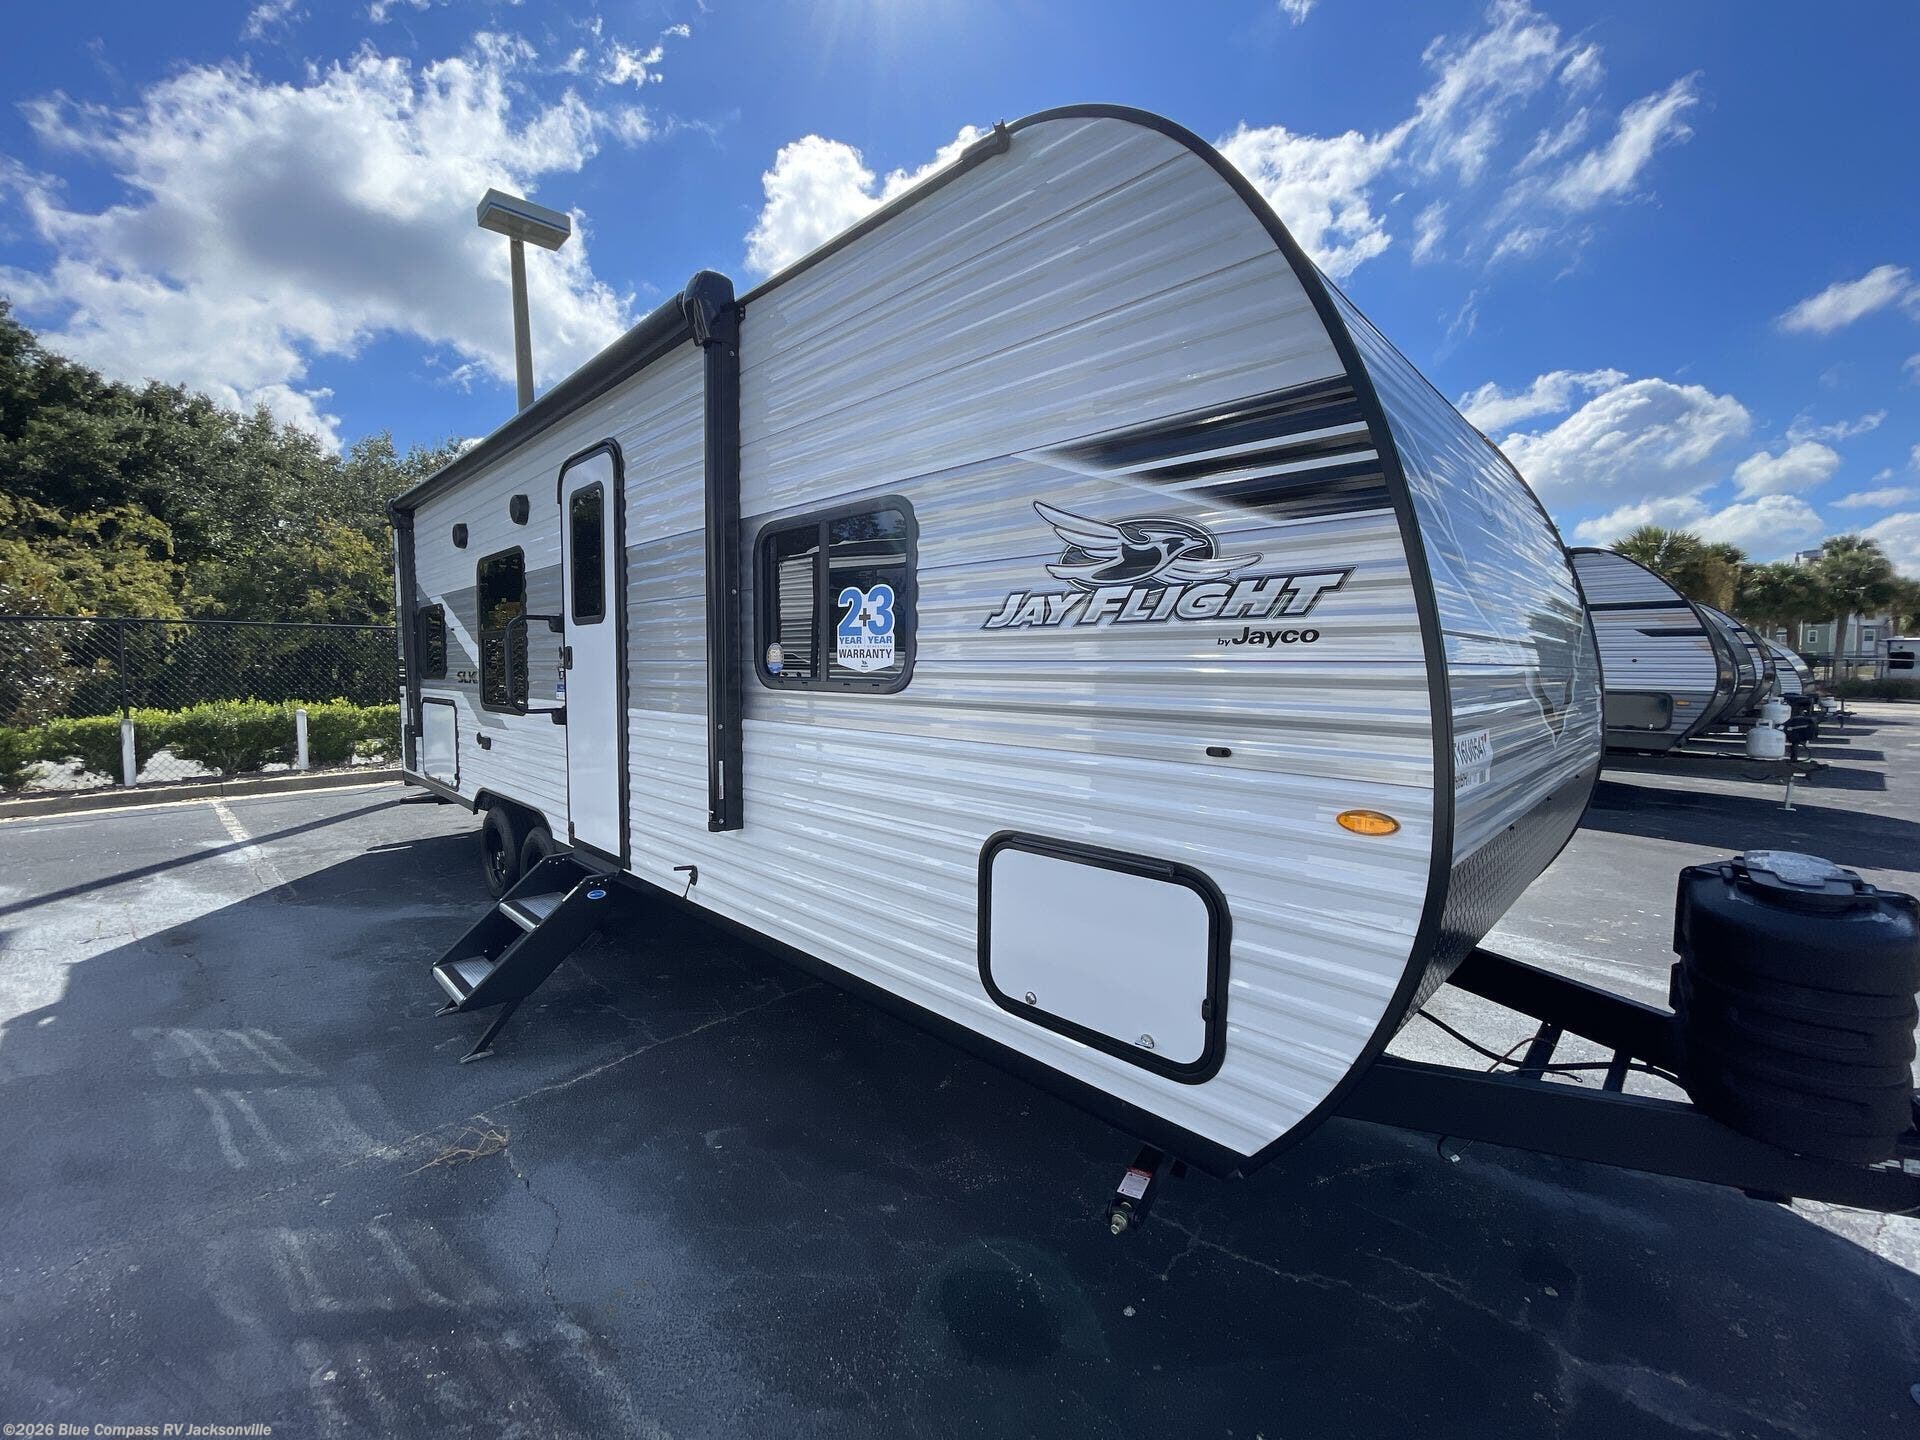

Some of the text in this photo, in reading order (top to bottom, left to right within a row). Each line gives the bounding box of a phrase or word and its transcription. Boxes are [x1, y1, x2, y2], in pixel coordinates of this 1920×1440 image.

[979, 564, 1359, 630] JAY FLIGHT
[839, 635, 893, 645] YEAR YEAR
[1217, 627, 1320, 648] by Jayco
[838, 648, 893, 659] WARRANTY
